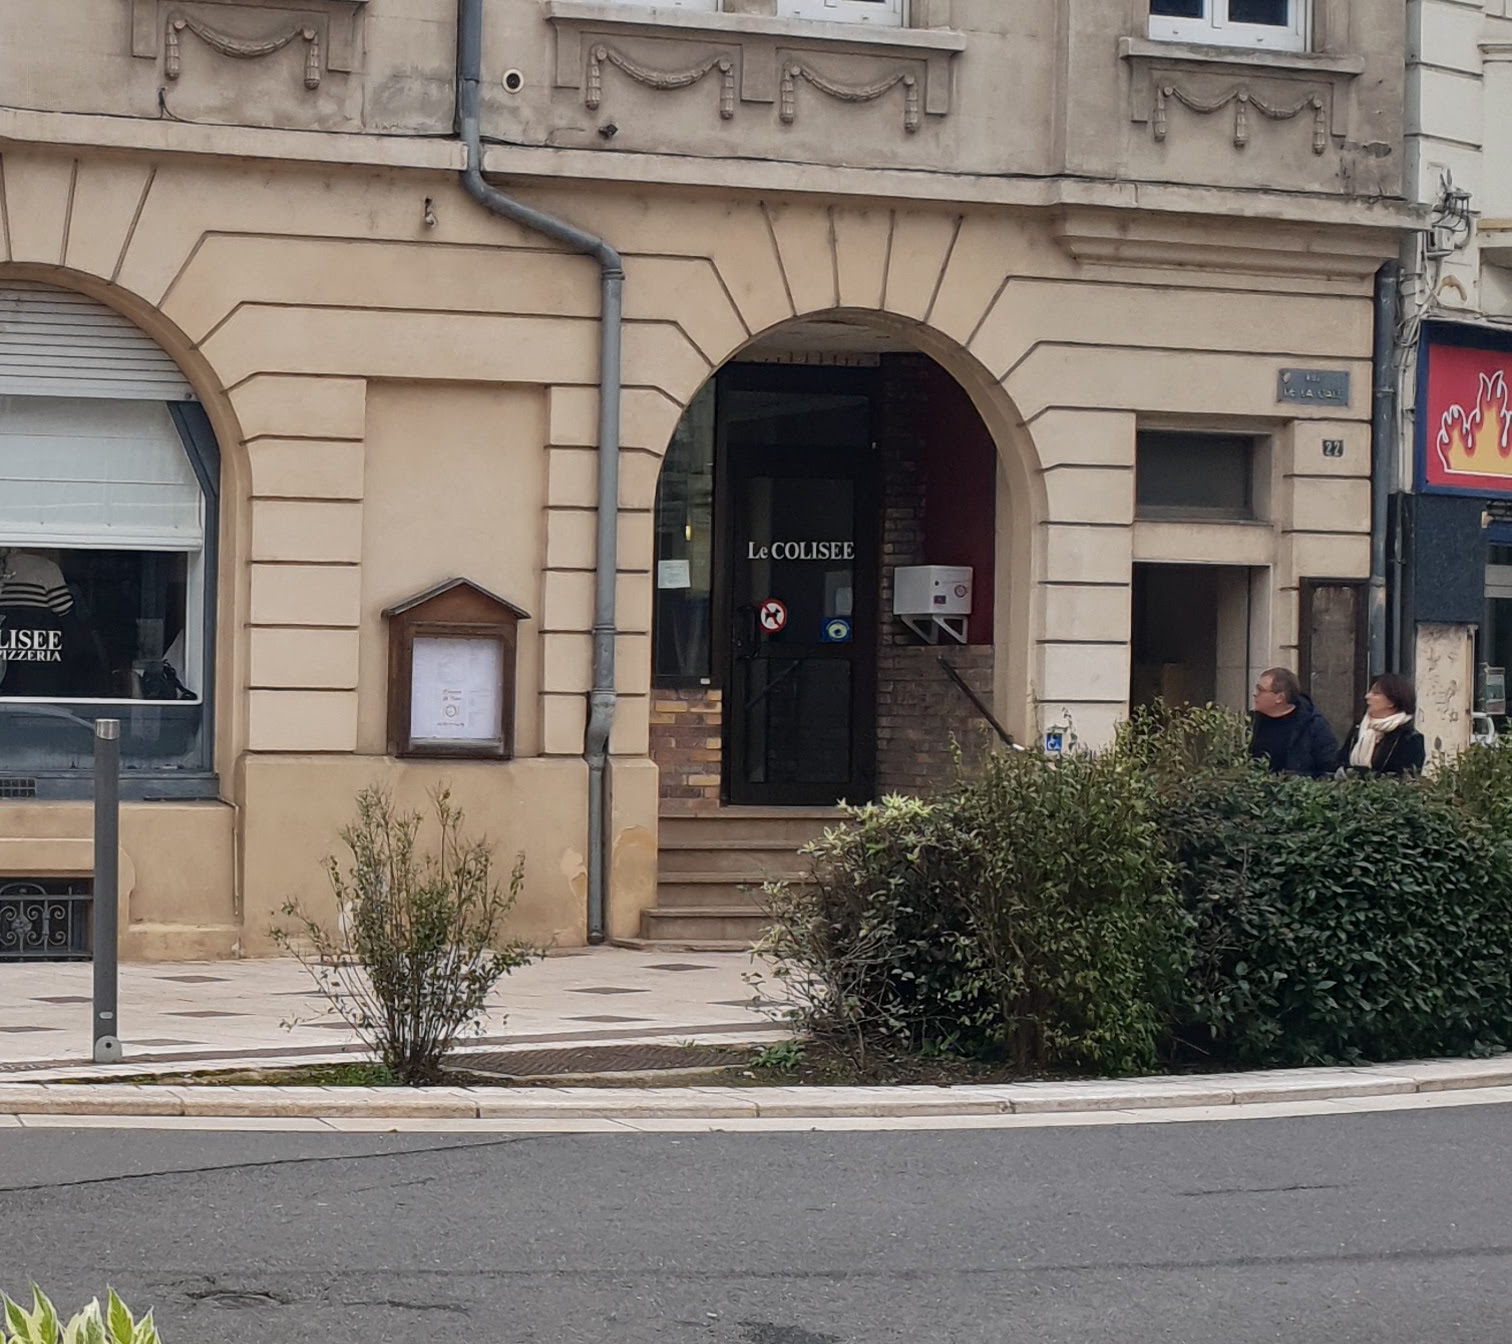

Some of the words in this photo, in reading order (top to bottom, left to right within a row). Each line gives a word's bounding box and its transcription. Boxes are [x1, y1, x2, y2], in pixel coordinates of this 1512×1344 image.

[1324, 441, 1341, 456] 22
[747, 541, 769, 560] Le
[771, 541, 856, 560] COLISEE
